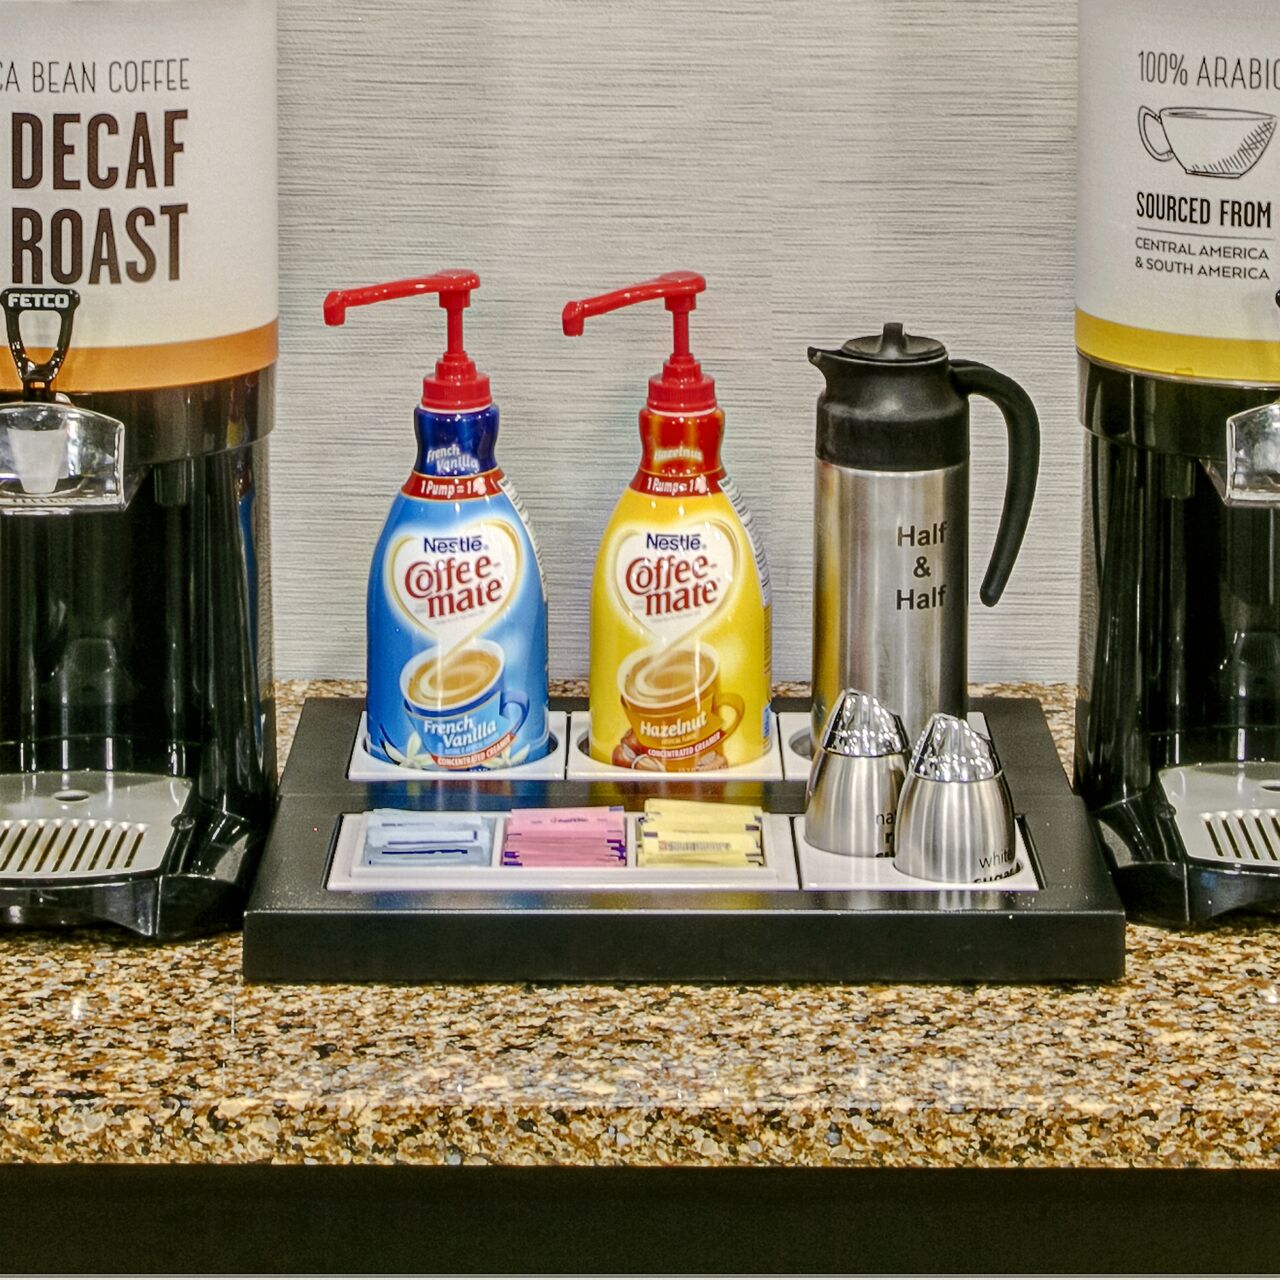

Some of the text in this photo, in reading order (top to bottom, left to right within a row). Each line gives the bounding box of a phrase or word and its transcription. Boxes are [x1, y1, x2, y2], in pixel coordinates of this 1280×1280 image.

[32, 61, 96, 93] BEAN
[108, 58, 190, 92] COFFEE
[1138, 50, 1188, 86] 100%
[11, 109, 189, 191] DECAF
[1136, 191, 1272, 229] SOURCED FROM
[11, 203, 189, 286] ROAST
[1135, 236, 1270, 260] CENTRAL AMERICA
[1135, 256, 1270, 280] & SOUTH AMERICA
[7, 293, 70, 309] FETCO
[436, 454, 480, 474] Vanilla
[421, 480, 426, 494] 1
[426, 480, 455, 499] Pump
[647, 477, 652, 490] 1
[652, 477, 679, 496] Pump
[897, 521, 948, 547] Half
[913, 556, 931, 578] &
[427, 579, 503, 618] mate
[645, 579, 718, 616] mate
[896, 585, 947, 610] Half
[424, 715, 474, 735] French
[442, 720, 497, 748] Vanilla
[640, 711, 708, 738] Hazelnut
